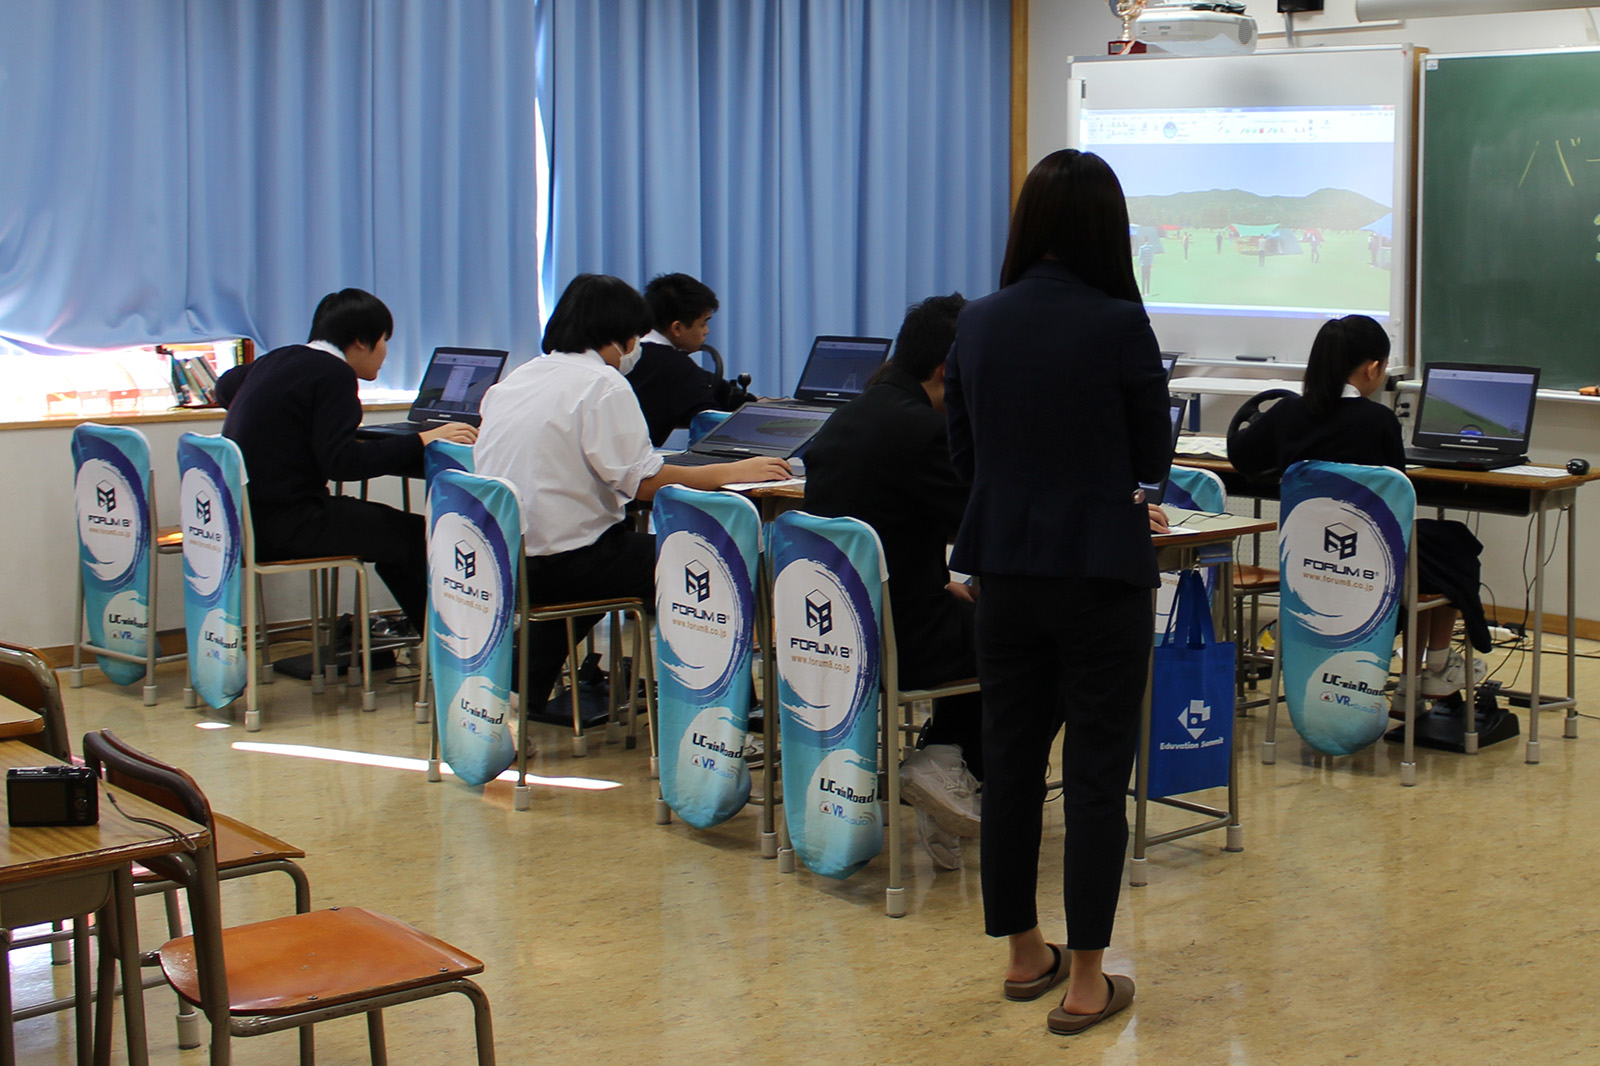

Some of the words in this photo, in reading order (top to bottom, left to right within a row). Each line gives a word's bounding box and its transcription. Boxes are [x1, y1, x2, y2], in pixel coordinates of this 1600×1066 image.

[88, 514, 121, 526] FORUM
[1303, 558, 1360, 577] FORUM
[443, 577, 479, 598] FORUM
[1303, 571, 1375, 592] www.forum8.co.jp
[672, 602, 715, 622] FORUM
[672, 618, 728, 639] www.forum8.co.jp
[791, 637, 839, 657] FORUM
[791, 655, 852, 675] www.forum8.co.jp
[847, 786, 876, 804] Road
